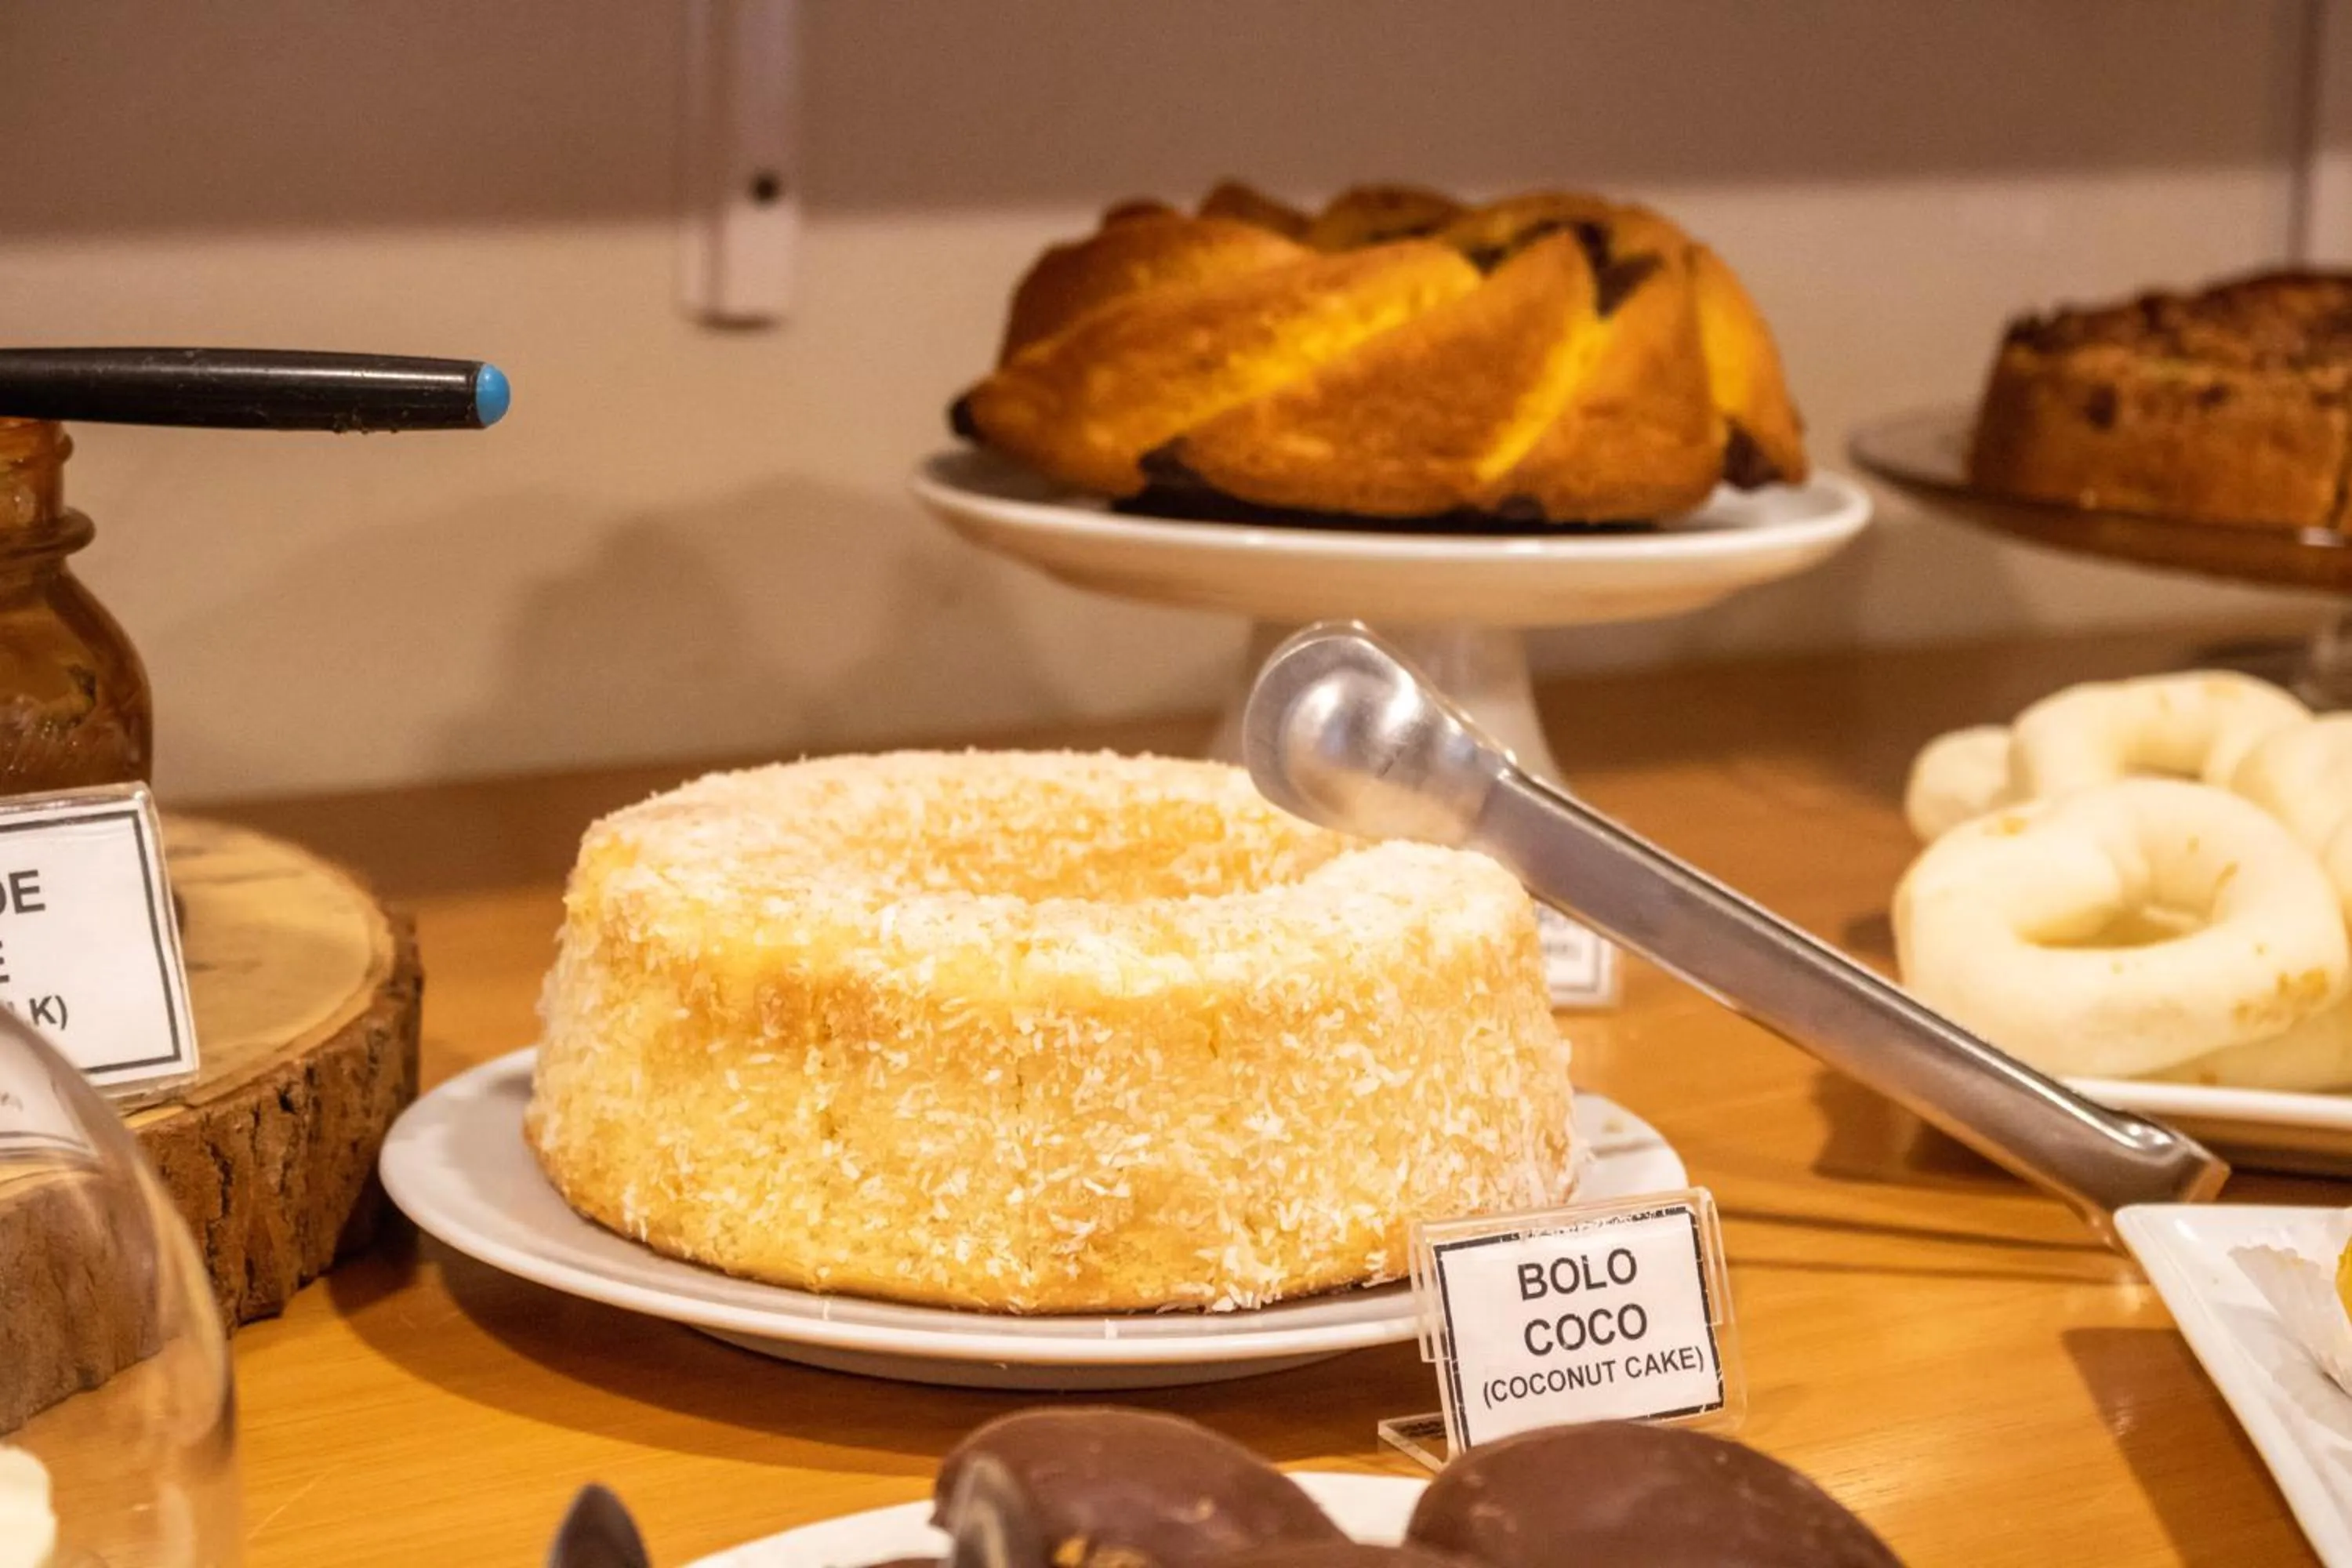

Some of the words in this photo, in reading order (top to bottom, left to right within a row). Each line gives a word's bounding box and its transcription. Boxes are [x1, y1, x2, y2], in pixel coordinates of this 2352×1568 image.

[0, 869, 46, 916] E
[7, 994, 68, 1031] K)
[1517, 1248, 1637, 1301] BOLO
[1524, 1303, 1647, 1356] COCO
[1483, 1360, 1617, 1409] (COCONUT
[1625, 1345, 1704, 1379] CAKE)
